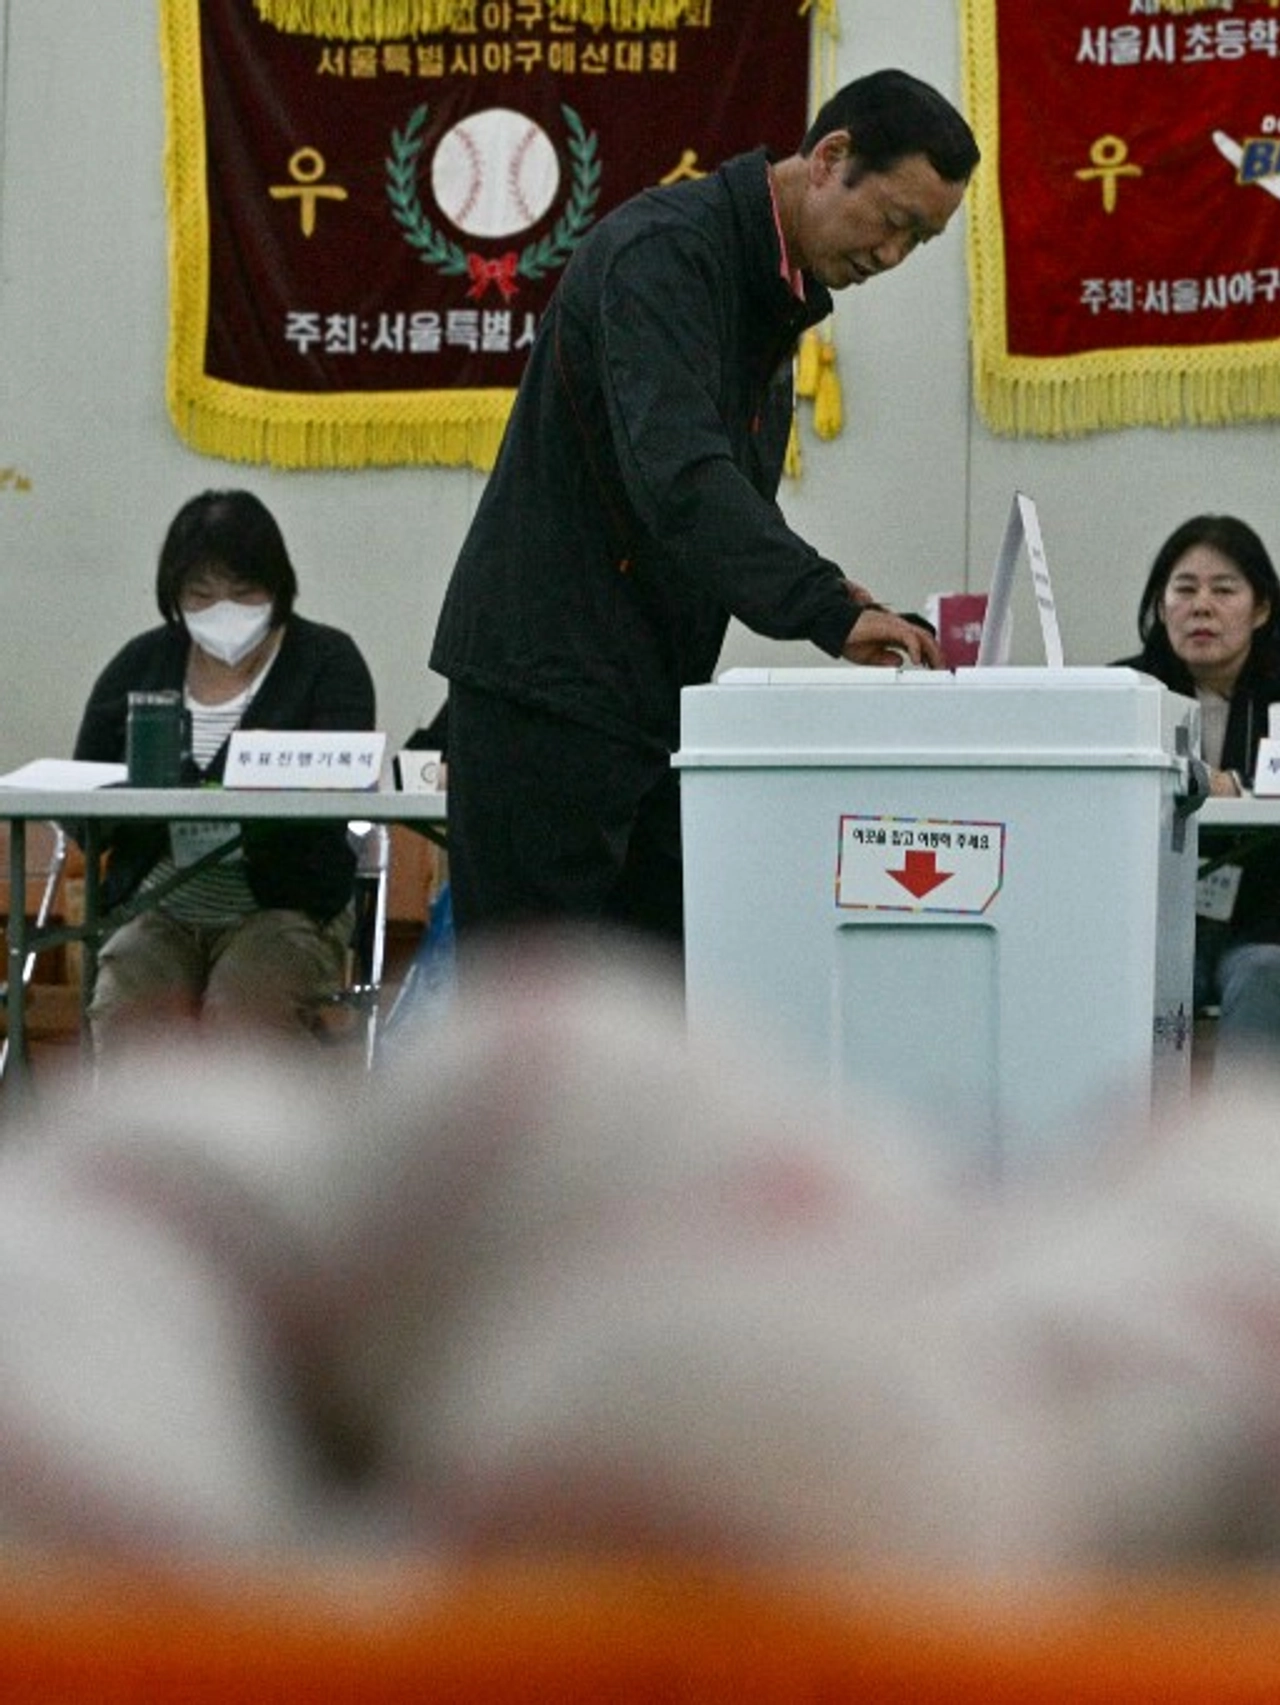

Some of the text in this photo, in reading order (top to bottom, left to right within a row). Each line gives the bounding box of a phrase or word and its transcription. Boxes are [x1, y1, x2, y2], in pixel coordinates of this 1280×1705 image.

[1076, 24, 1175, 66] 서울시
[269, 146, 348, 238] 우
[1075, 135, 1142, 213] 우
